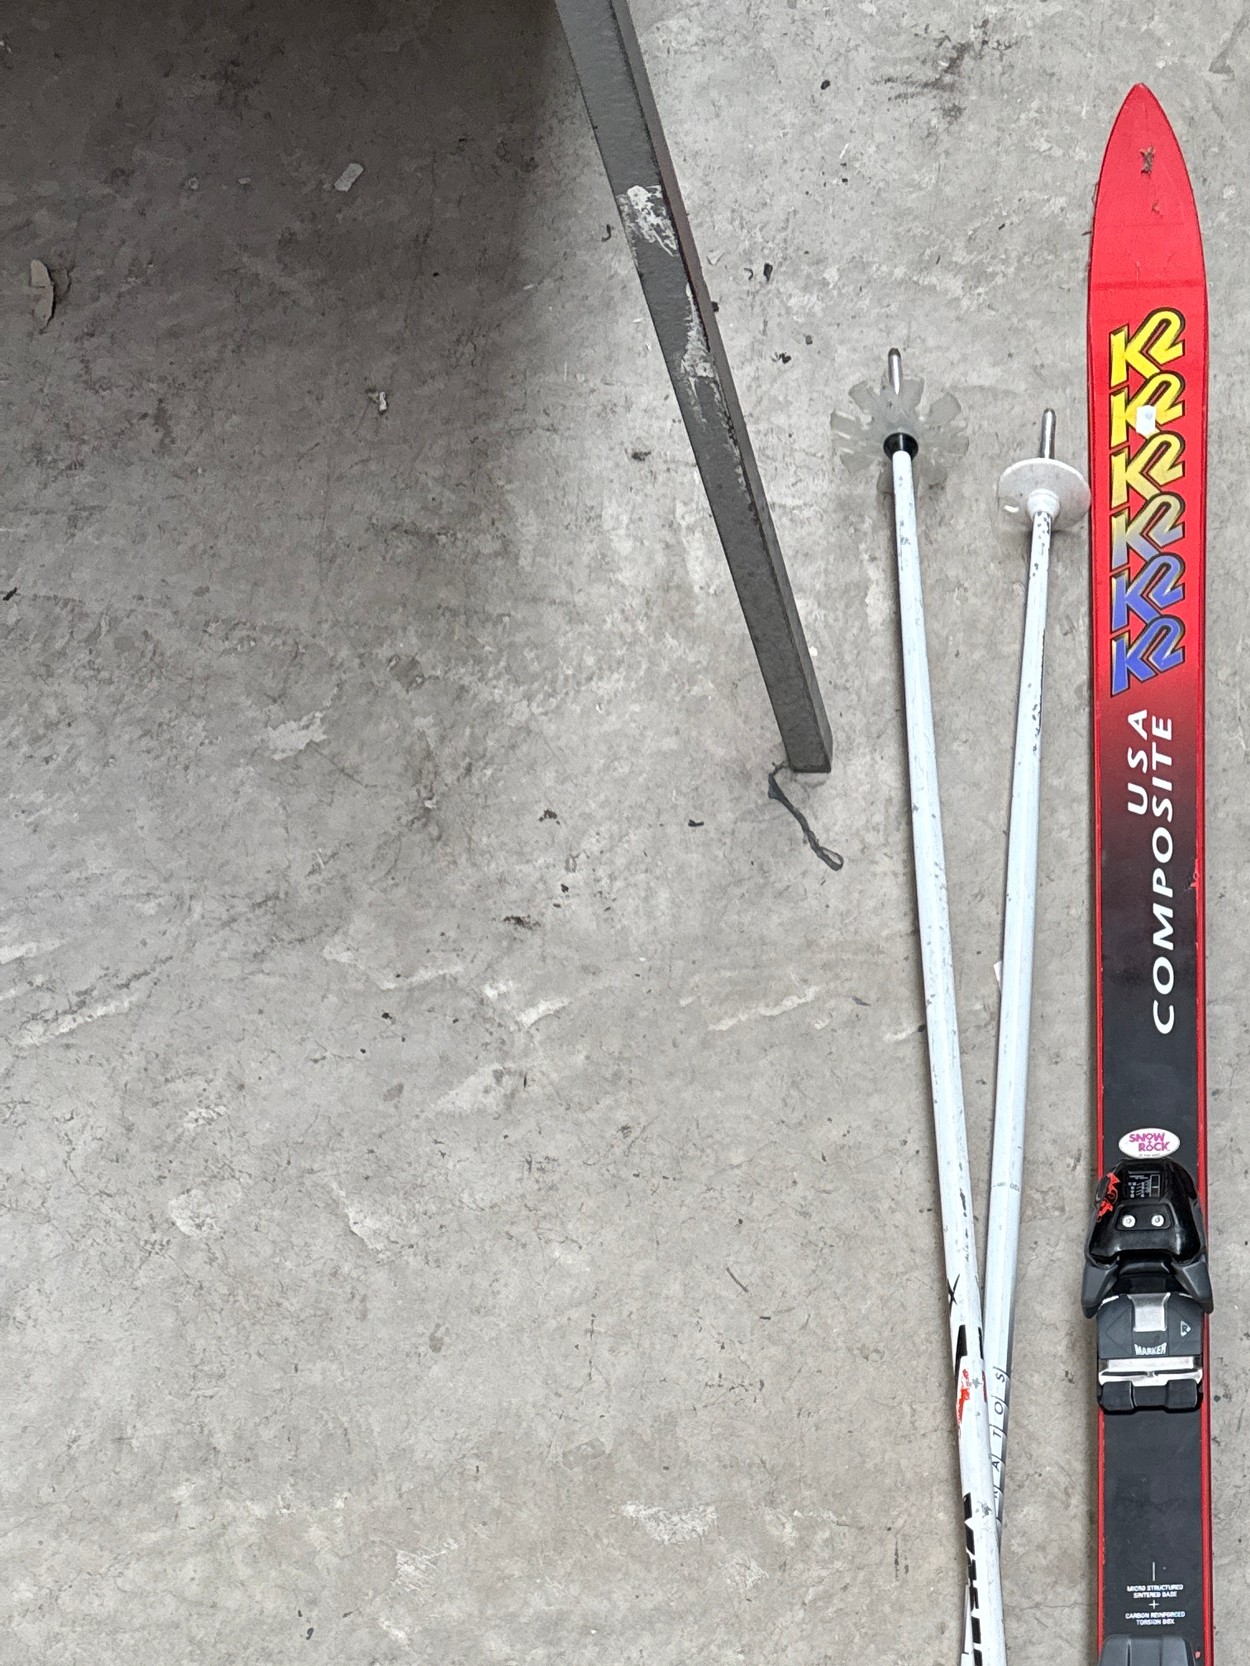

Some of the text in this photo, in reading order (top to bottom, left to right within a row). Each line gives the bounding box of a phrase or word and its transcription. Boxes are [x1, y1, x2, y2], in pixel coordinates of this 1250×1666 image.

[1110, 307, 1187, 388] K2
[1110, 431, 1187, 509] K2
[1110, 492, 1187, 573] K2
[1110, 553, 1187, 633] K2
[1110, 614, 1187, 698] K2
[1127, 709, 1148, 815] USA
[1152, 715, 1175, 1035] COMPOSITE
[1129, 1133, 1165, 1143] SNOW
[1138, 1142, 1170, 1152] ROCK
[1134, 1342, 1167, 1355] MARKER
